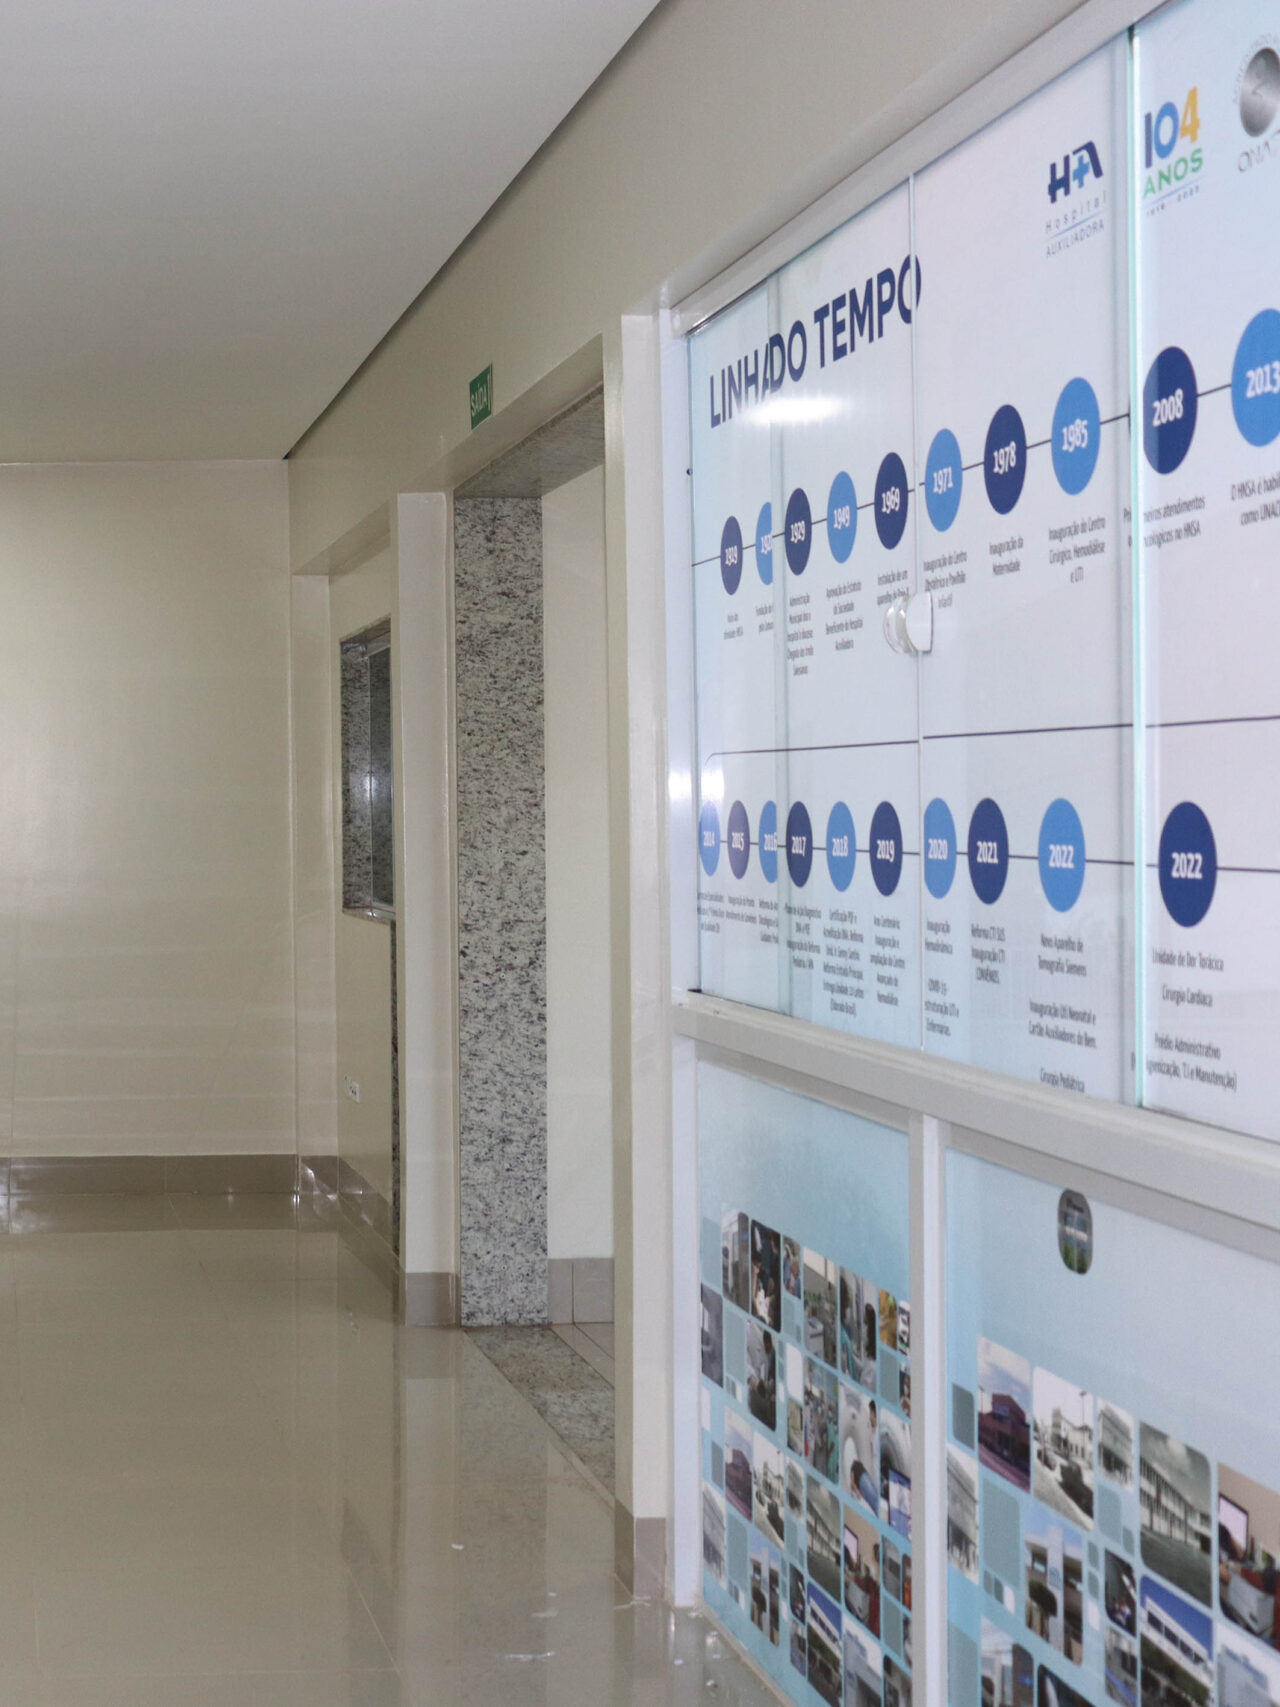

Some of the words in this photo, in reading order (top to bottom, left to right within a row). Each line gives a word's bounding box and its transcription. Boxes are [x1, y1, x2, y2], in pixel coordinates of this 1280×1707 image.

[1144, 86, 1200, 169] 104
[1144, 148, 1203, 199] ANOS
[1045, 190, 1107, 234] Hospital
[1046, 219, 1105, 258] AUXILIADORA
[710, 343, 770, 428] LINHA
[769, 320, 807, 394] DO
[814, 254, 922, 369] TEMPO
[1246, 360, 1280, 399] 2013
[1152, 388, 1184, 427] 2008
[1061, 418, 1089, 453] 1985
[993, 441, 1017, 474] 1978
[933, 466, 954, 495] 1971
[1237, 480, 1256, 498] HNSA
[881, 487, 901, 514] 1969
[1163, 496, 1206, 518] atendimentos
[833, 505, 851, 529] 1949
[1049, 521, 1080, 542] Inauguração
[1088, 515, 1105, 532] Centro
[1240, 510, 1259, 525] como
[790, 521, 806, 543] 1929
[1183, 520, 1201, 538] HNSA
[725, 545, 738, 566] 1919
[761, 534, 772, 554] 192
[731, 832, 745, 851] 2015
[792, 836, 807, 857] 2017
[832, 835, 849, 857] 2018
[876, 840, 895, 863] 2019
[928, 838, 949, 860] 2020
[976, 841, 998, 864] 2021
[1049, 844, 1074, 868] 2022
[1171, 852, 1203, 879] 2022
[1040, 933, 1053, 949] Novo
[1054, 936, 1076, 952] Aparelho
[1038, 955, 1065, 974] Tomografia
[1152, 949, 1177, 966] Unidade
[1177, 951, 1185, 966] de
[1186, 952, 1197, 967] Dor
[1162, 985, 1186, 1006] Cirurgia
[1187, 987, 1213, 1007] Cardíaca
[1029, 999, 1059, 1018] Inauguração
[1028, 1020, 1044, 1036] Cartão
[1155, 1033, 1173, 1050] Prédio
[1174, 1038, 1221, 1060] Administrativo
[1195, 1066, 1238, 1090] Manutenção)
